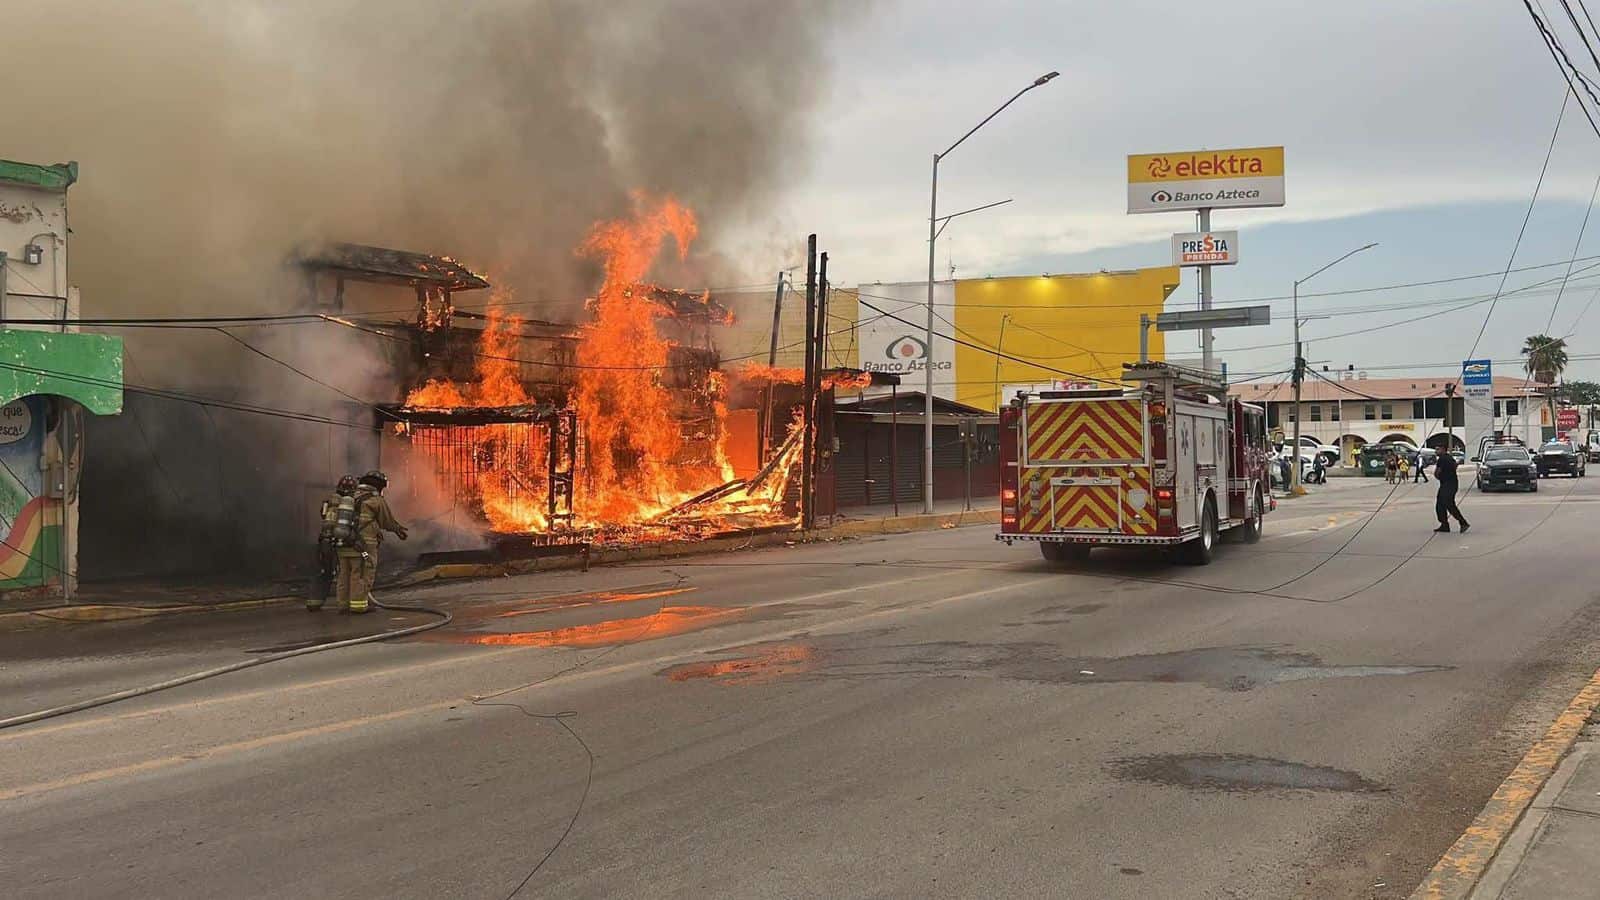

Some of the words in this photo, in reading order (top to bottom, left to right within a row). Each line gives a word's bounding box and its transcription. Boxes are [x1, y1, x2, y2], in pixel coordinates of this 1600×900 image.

[1176, 154, 1262, 176] elektra
[1175, 191, 1213, 202] Banco
[1216, 189, 1260, 200] Azteca
[863, 361, 902, 371] Banco
[3, 407, 24, 420] que
